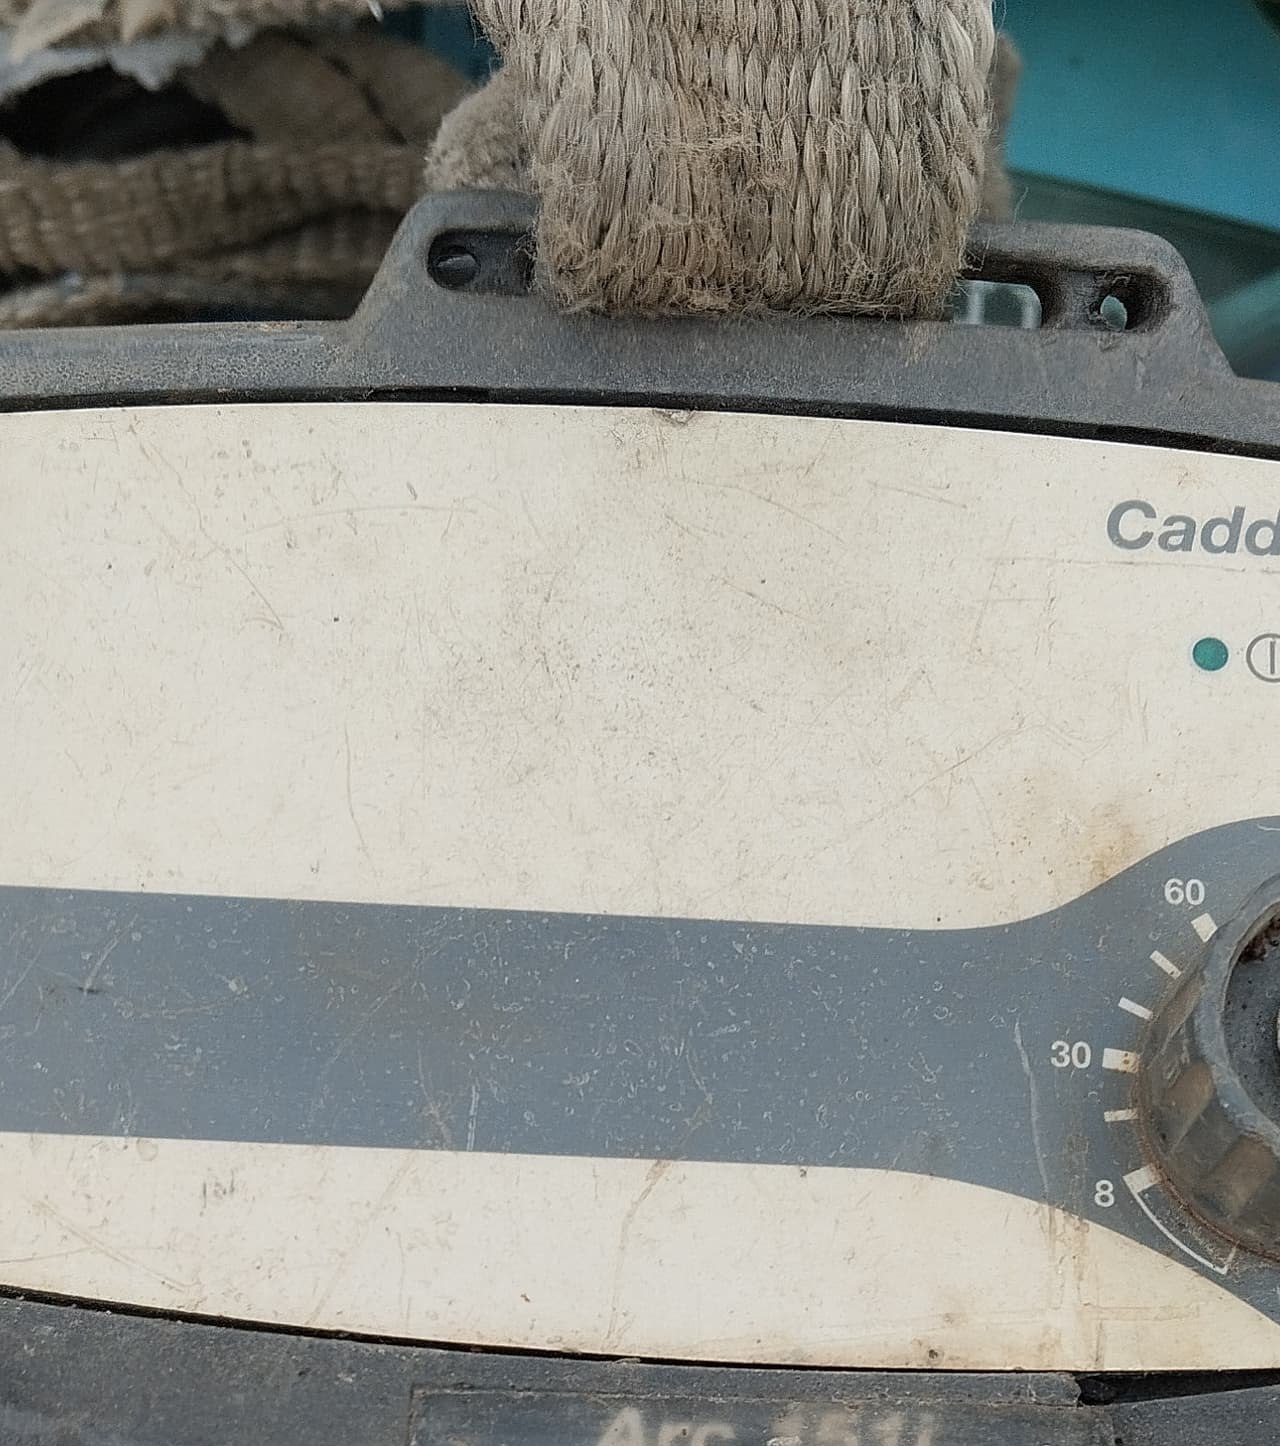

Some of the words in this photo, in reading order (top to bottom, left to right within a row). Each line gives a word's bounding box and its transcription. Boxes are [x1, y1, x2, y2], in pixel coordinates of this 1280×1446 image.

[1164, 879, 1206, 905] 60
[1050, 1041, 1092, 1069] 30
[1094, 1180, 1116, 1208] 8
